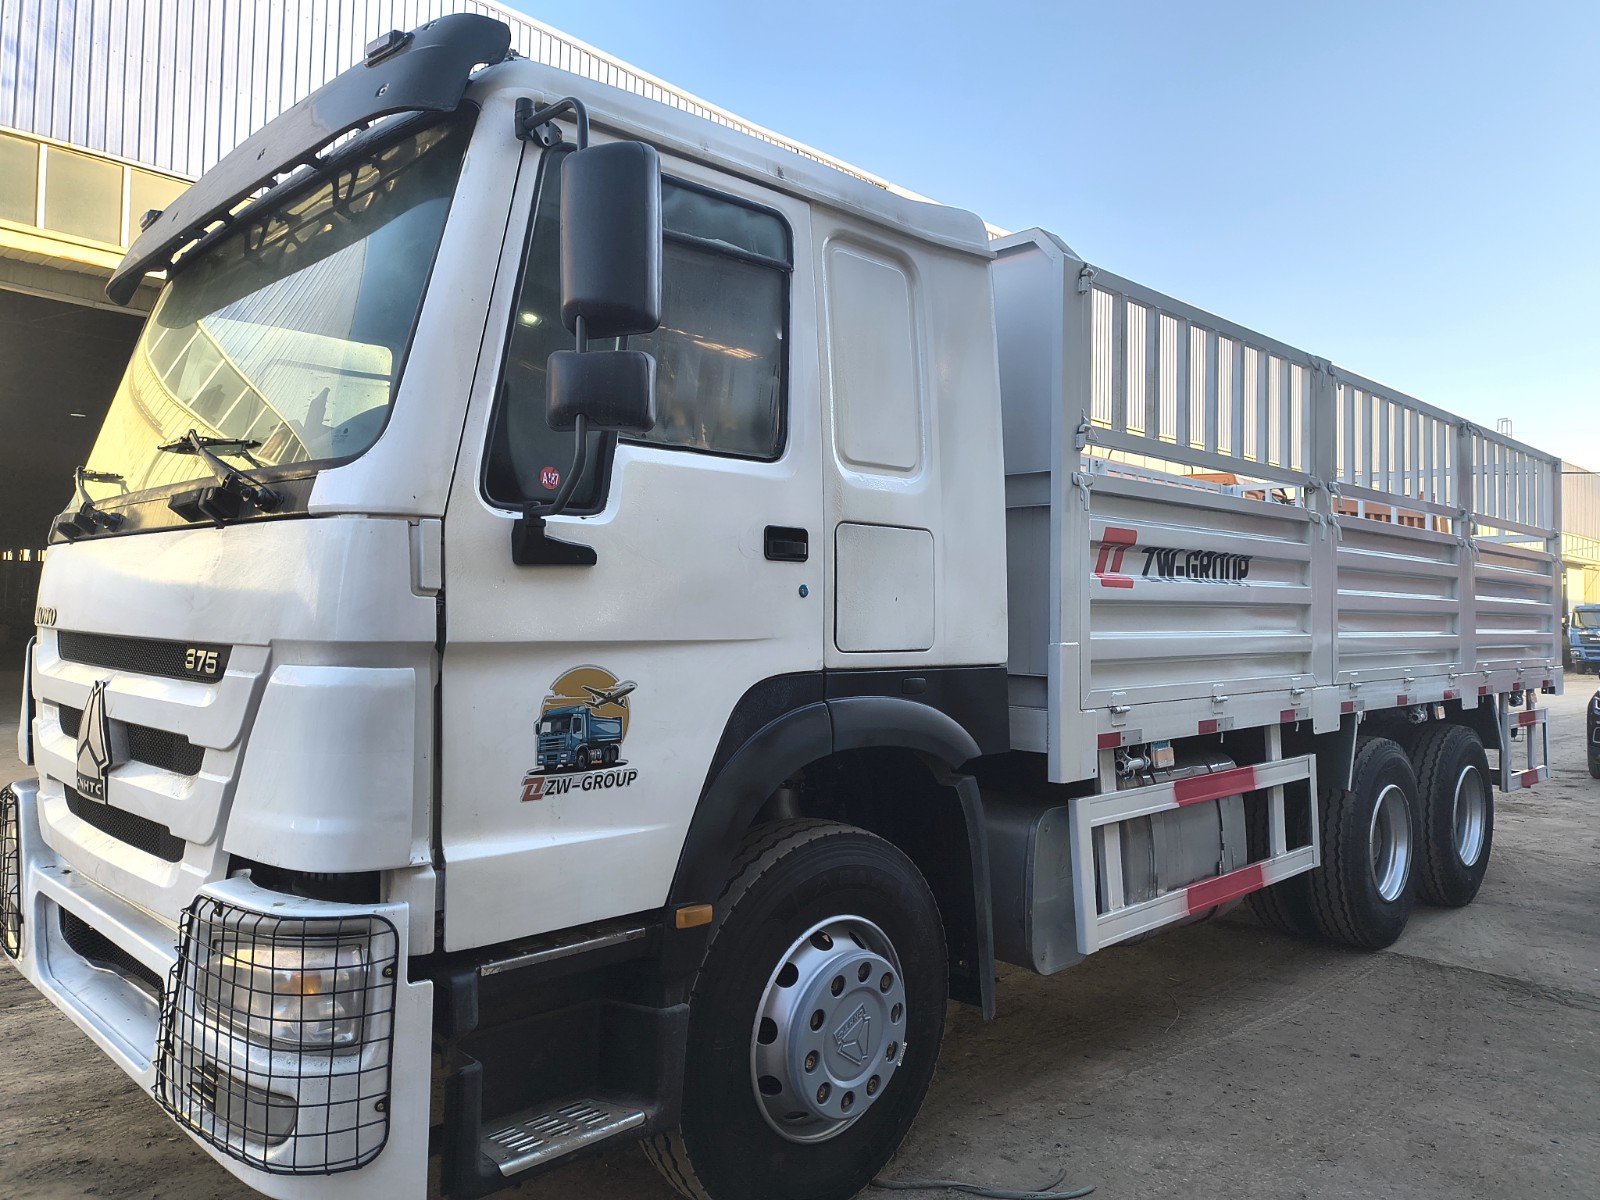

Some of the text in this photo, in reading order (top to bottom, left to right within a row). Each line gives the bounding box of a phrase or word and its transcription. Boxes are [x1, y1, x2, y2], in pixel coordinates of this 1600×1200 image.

[34, 606, 57, 626] OWO
[184, 648, 219, 674] 375
[544, 771, 637, 796] ZW-GROUP
